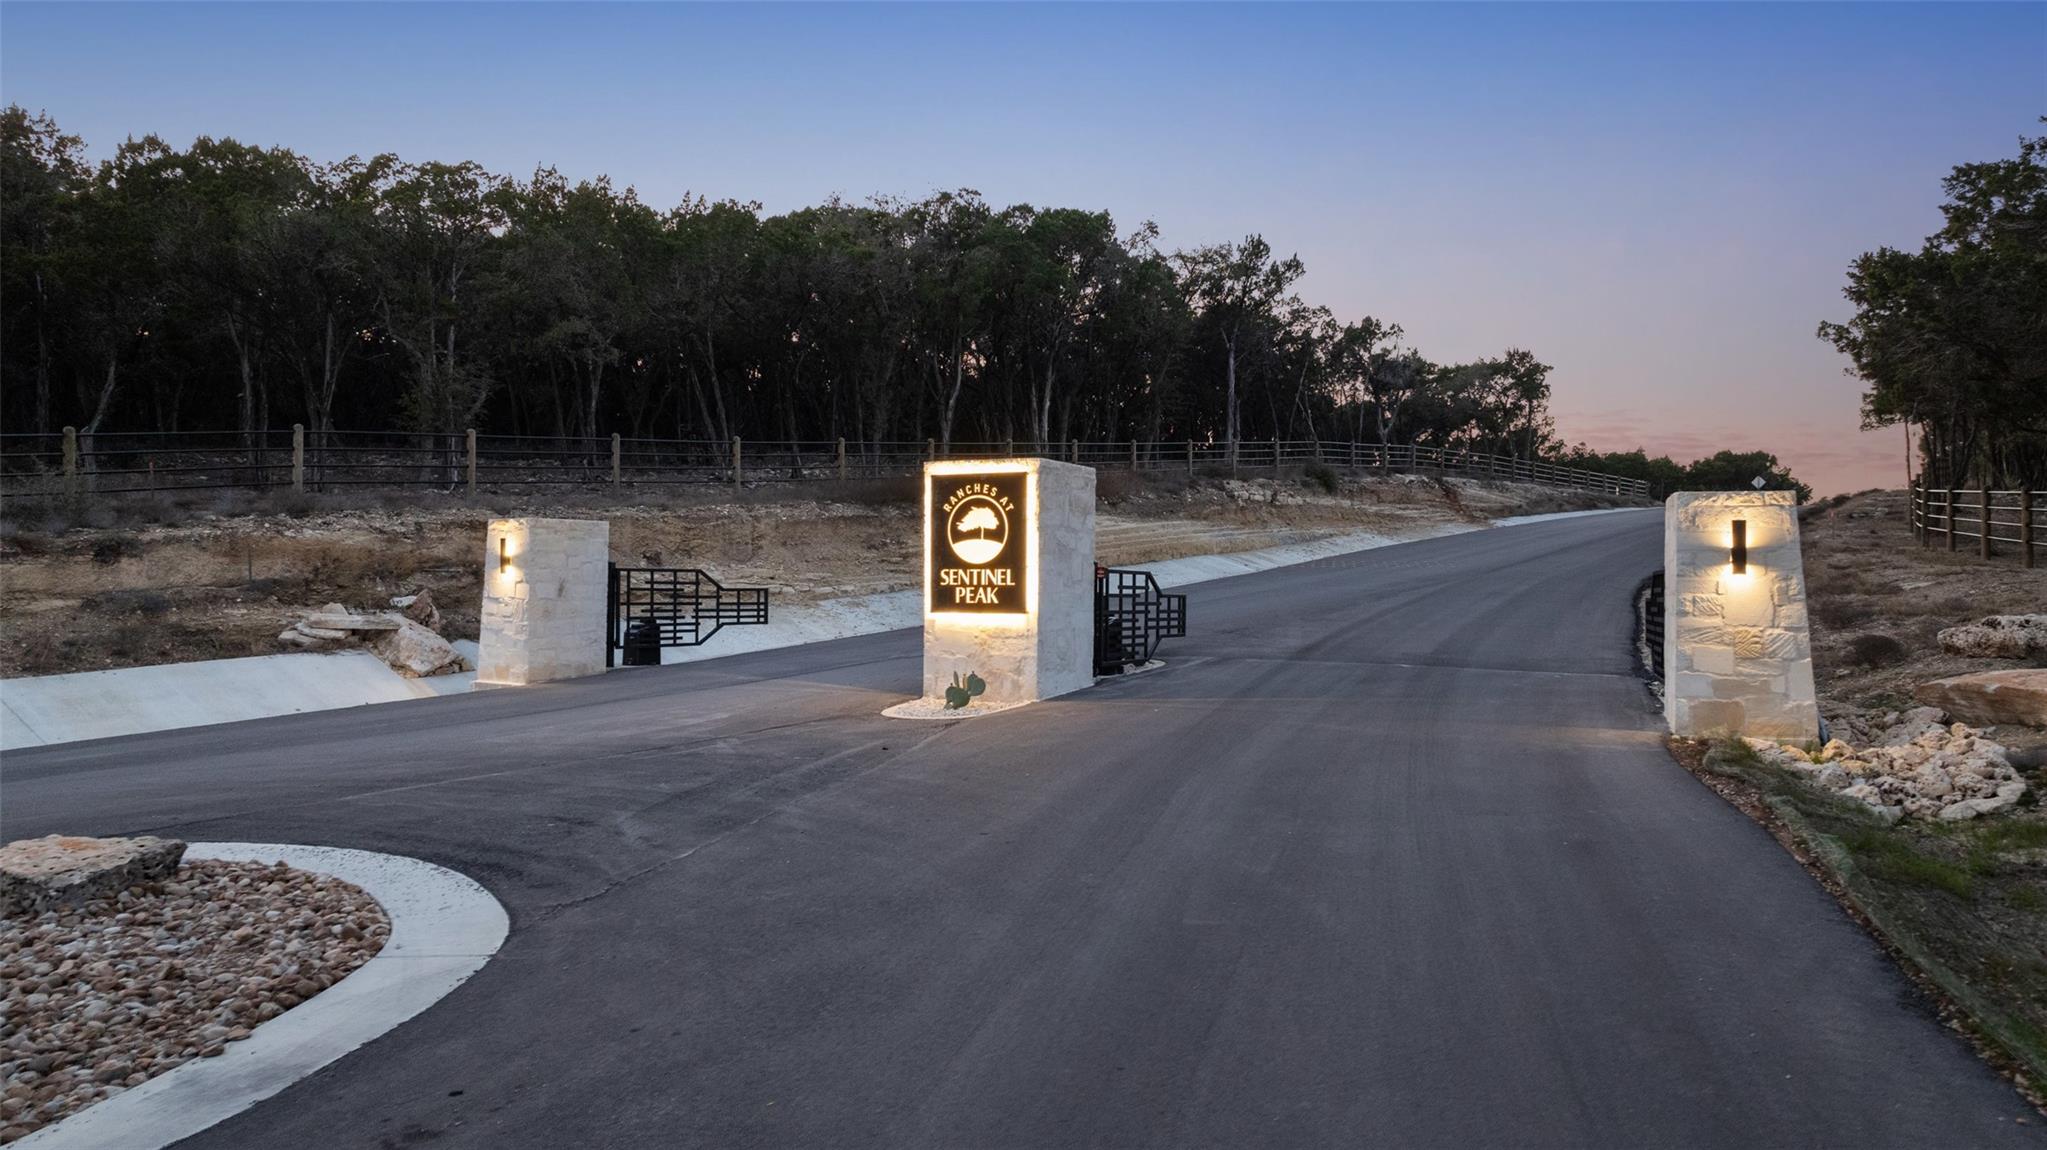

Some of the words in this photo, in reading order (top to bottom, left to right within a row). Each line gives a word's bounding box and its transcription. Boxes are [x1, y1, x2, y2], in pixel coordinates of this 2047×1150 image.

[943, 483, 997, 512] RANCHES
[1000, 496, 1014, 511] AT
[940, 568, 1015, 586] SENTINEL
[955, 586, 999, 604] PEAK
